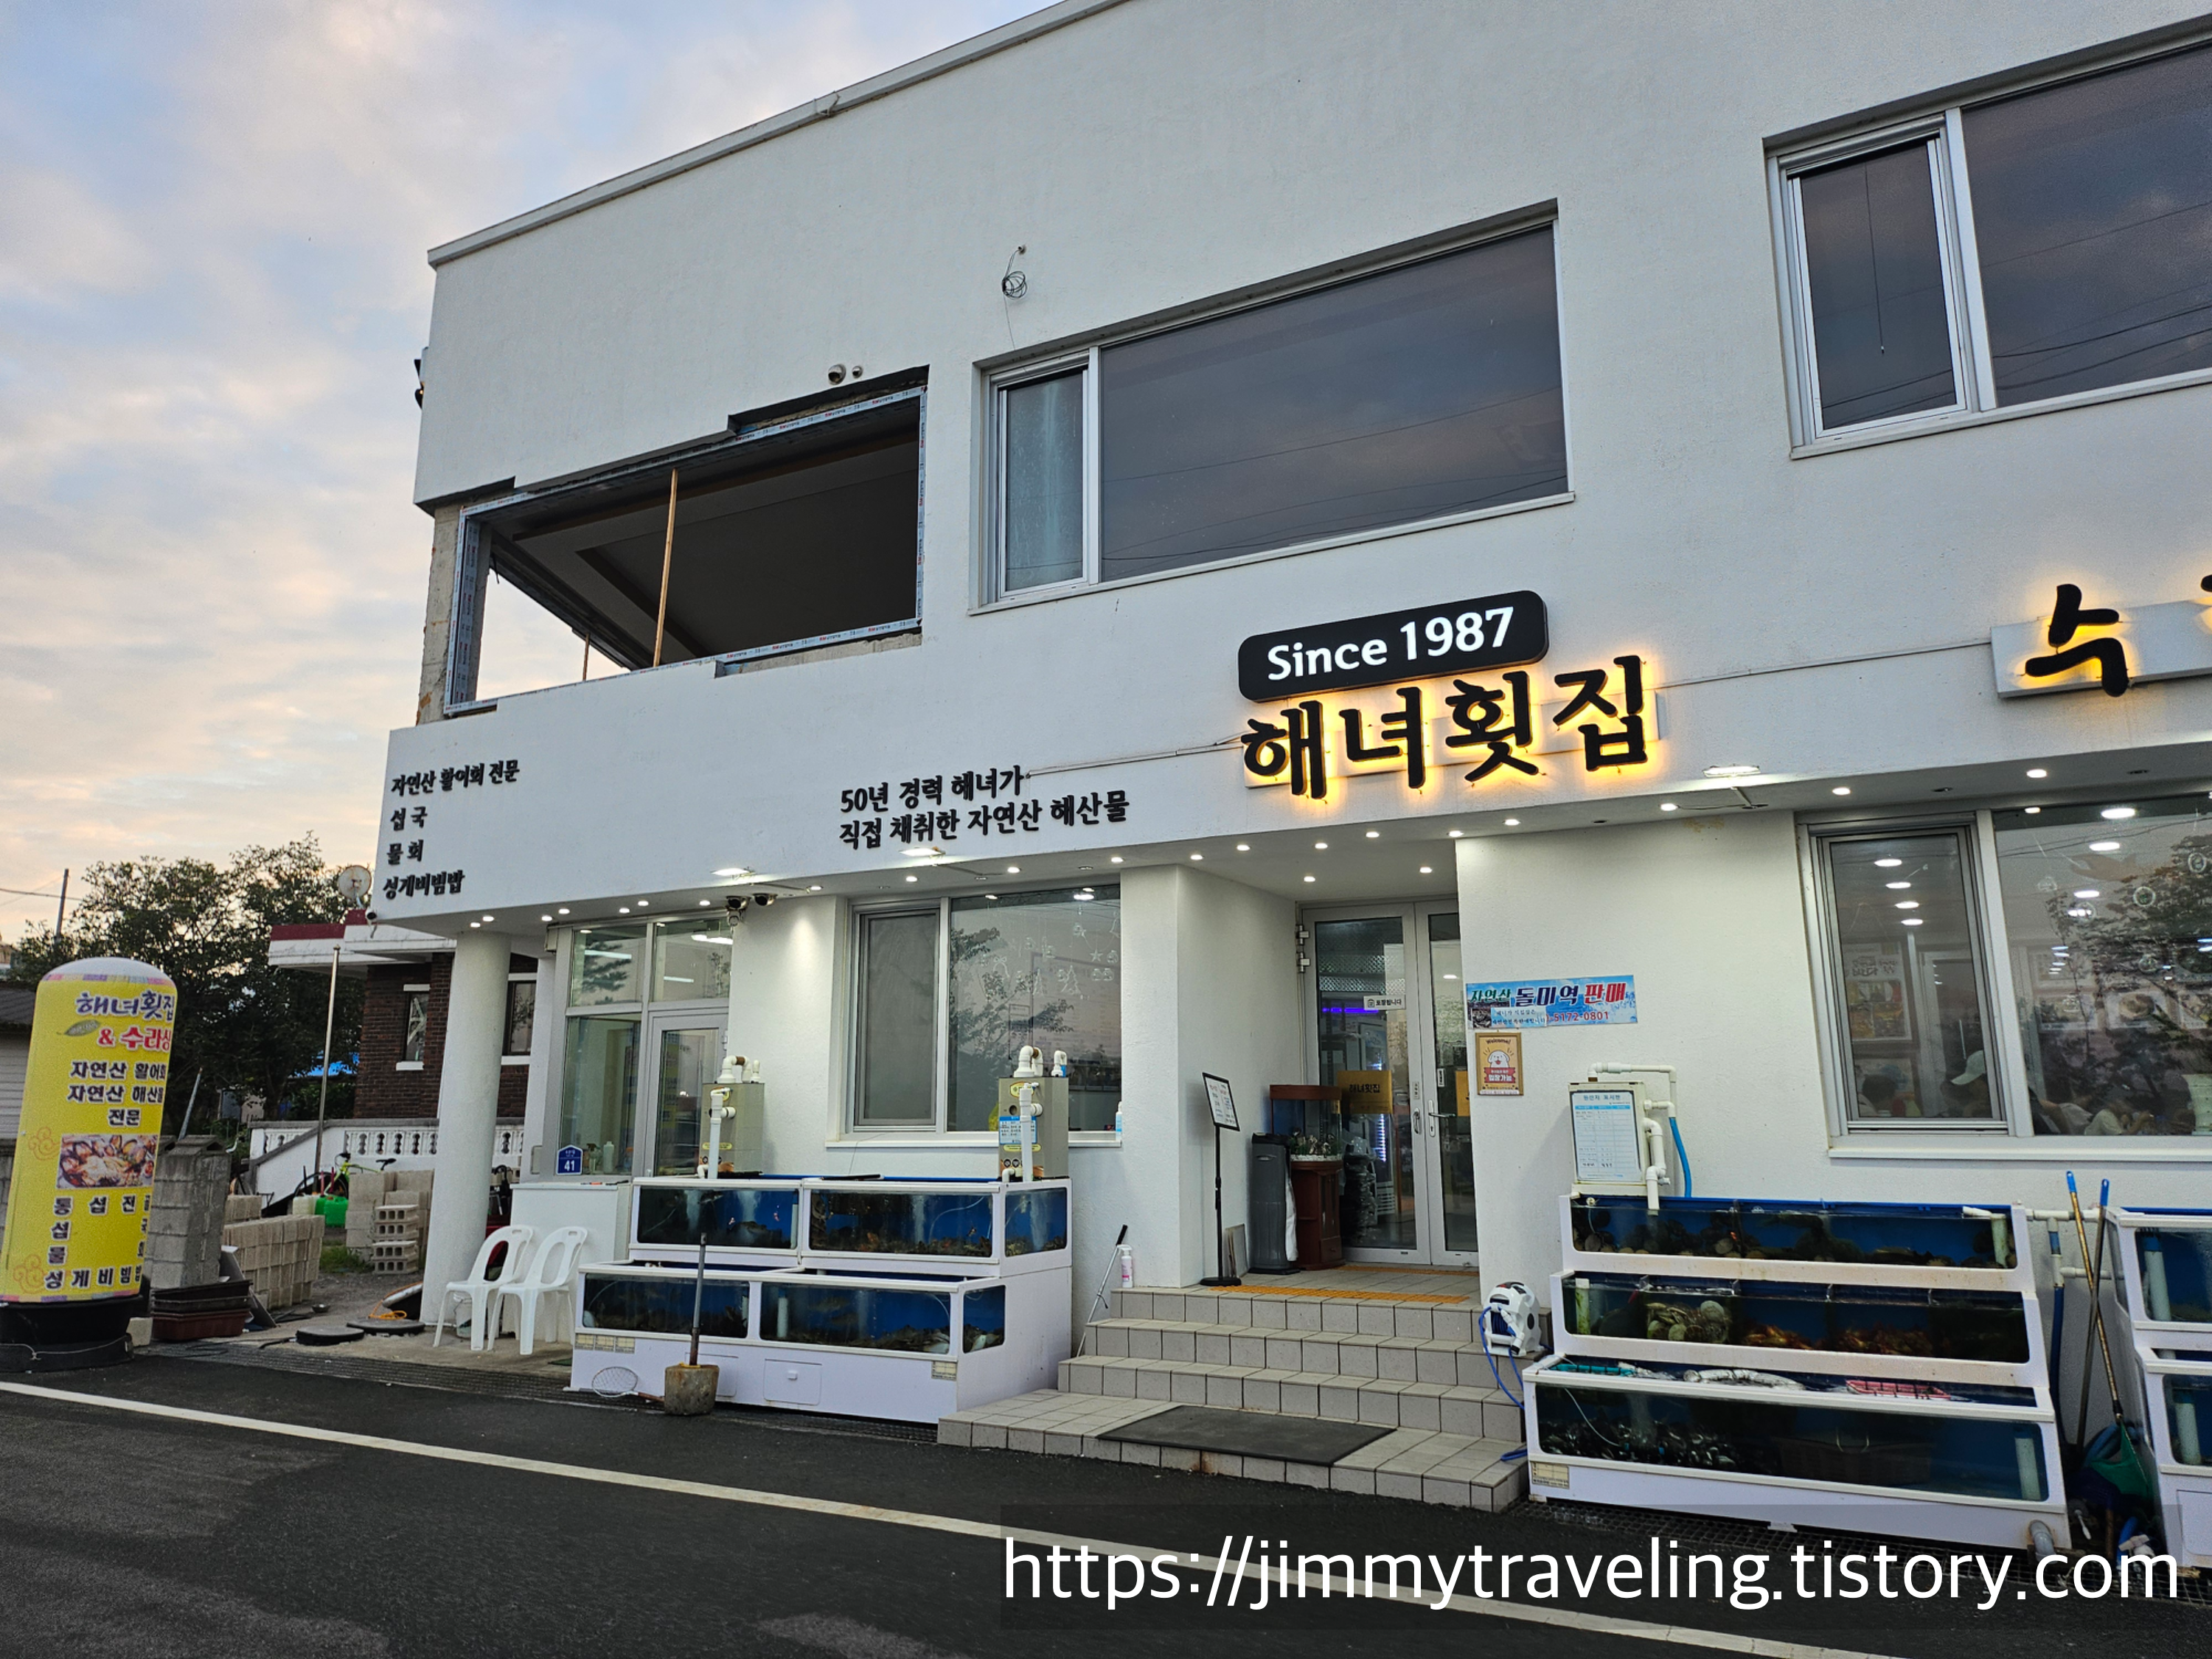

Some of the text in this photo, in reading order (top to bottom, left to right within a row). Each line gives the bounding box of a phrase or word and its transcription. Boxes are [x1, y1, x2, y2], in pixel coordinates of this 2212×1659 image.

[1267, 606, 1515, 681] Since 1987
[1241, 655, 1649, 799] 해녀횟집
[391, 759, 521, 797] 자연산 활어회 전문
[841, 765, 1024, 813] 50년 경력 해녀가
[839, 789, 1130, 850] 직접 채취한 자연산 해산물
[383, 869, 465, 900] 성게비빔밥
[76, 990, 175, 1022] 해녀횟집
[1470, 982, 1627, 1007] 자연산 돌미역 판매
[98, 1029, 114, 1046] &
[70, 1061, 128, 1079] 자연산
[67, 1085, 125, 1102] 자연산
[108, 1109, 140, 1126] 전문
[564, 1160, 575, 1172] 41
